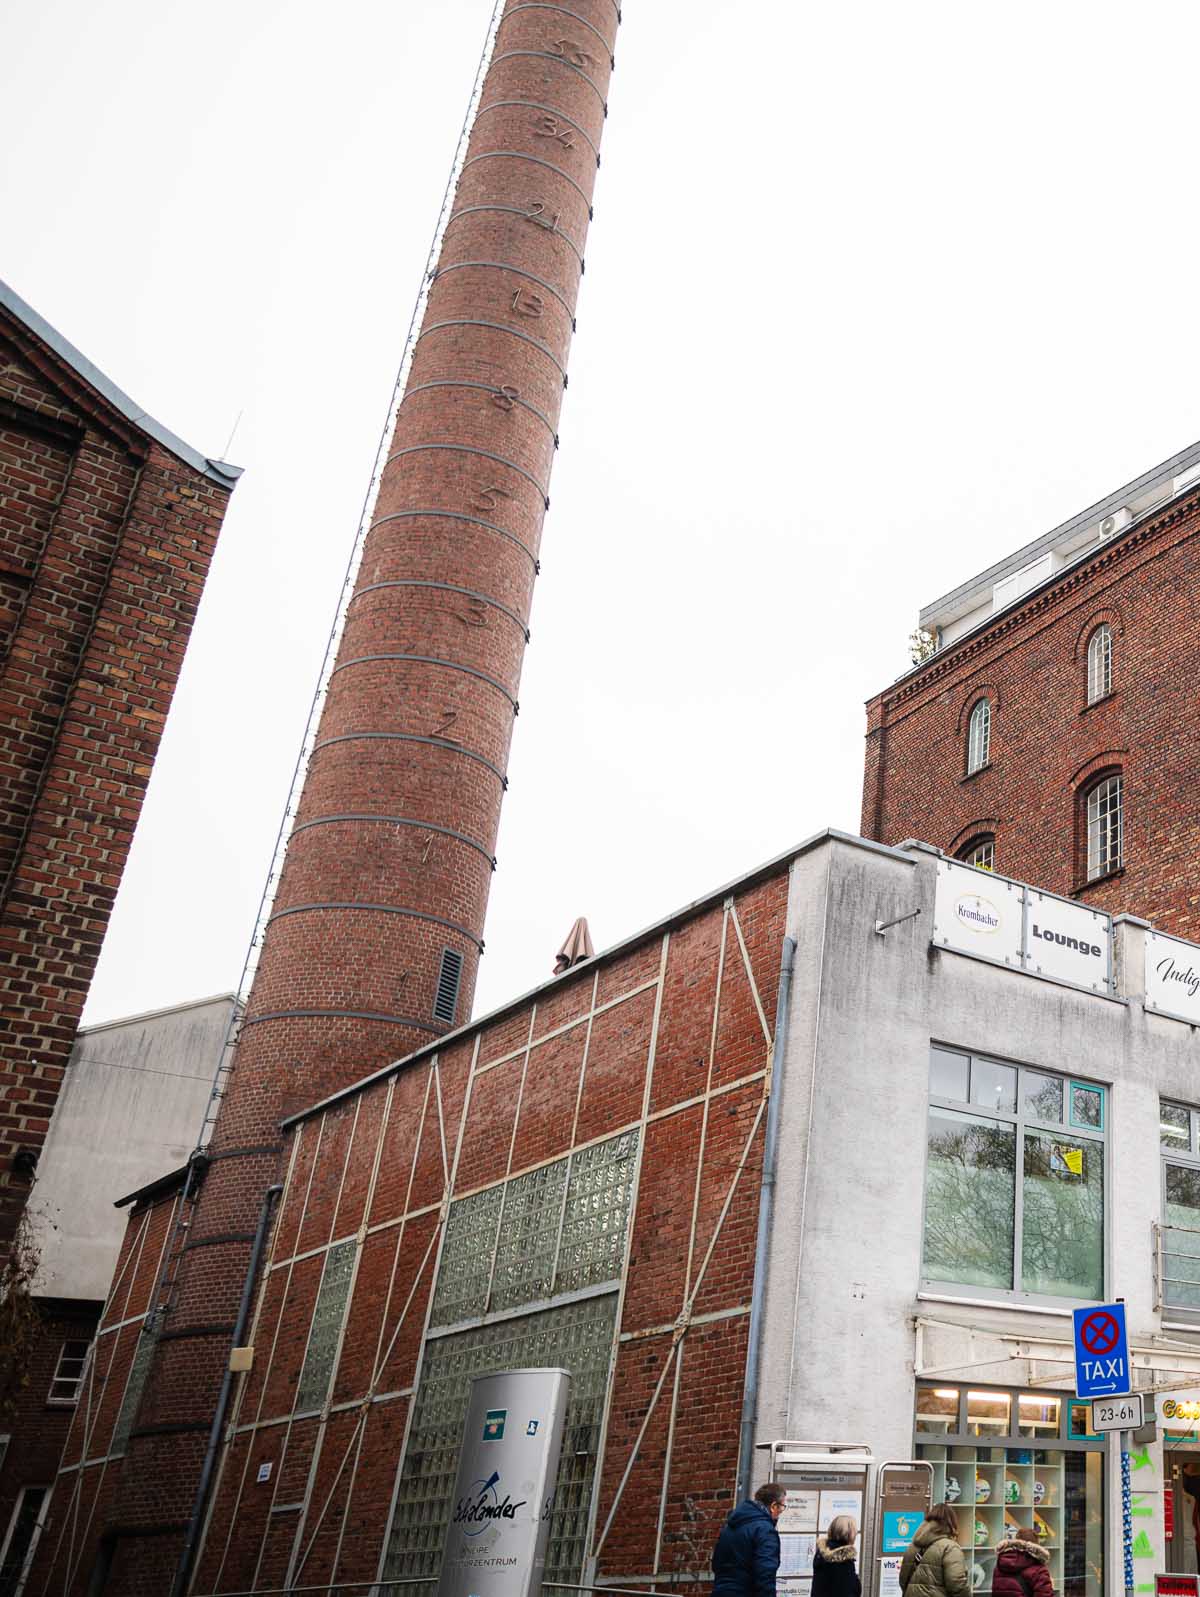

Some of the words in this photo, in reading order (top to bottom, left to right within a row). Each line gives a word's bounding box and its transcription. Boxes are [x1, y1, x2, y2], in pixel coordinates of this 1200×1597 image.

[548, 38, 601, 68] 55
[537, 115, 577, 149] 34
[526, 202, 561, 233] 21
[512, 287, 544, 318] 13
[493, 384, 521, 412] 8
[471, 486, 511, 514] 5
[431, 711, 462, 743] 2
[958, 904, 999, 927] Krombacher
[1032, 924, 1102, 957] Lounge
[1081, 1358, 1124, 1380] TAXI
[883, 1561, 896, 1570] vhs
